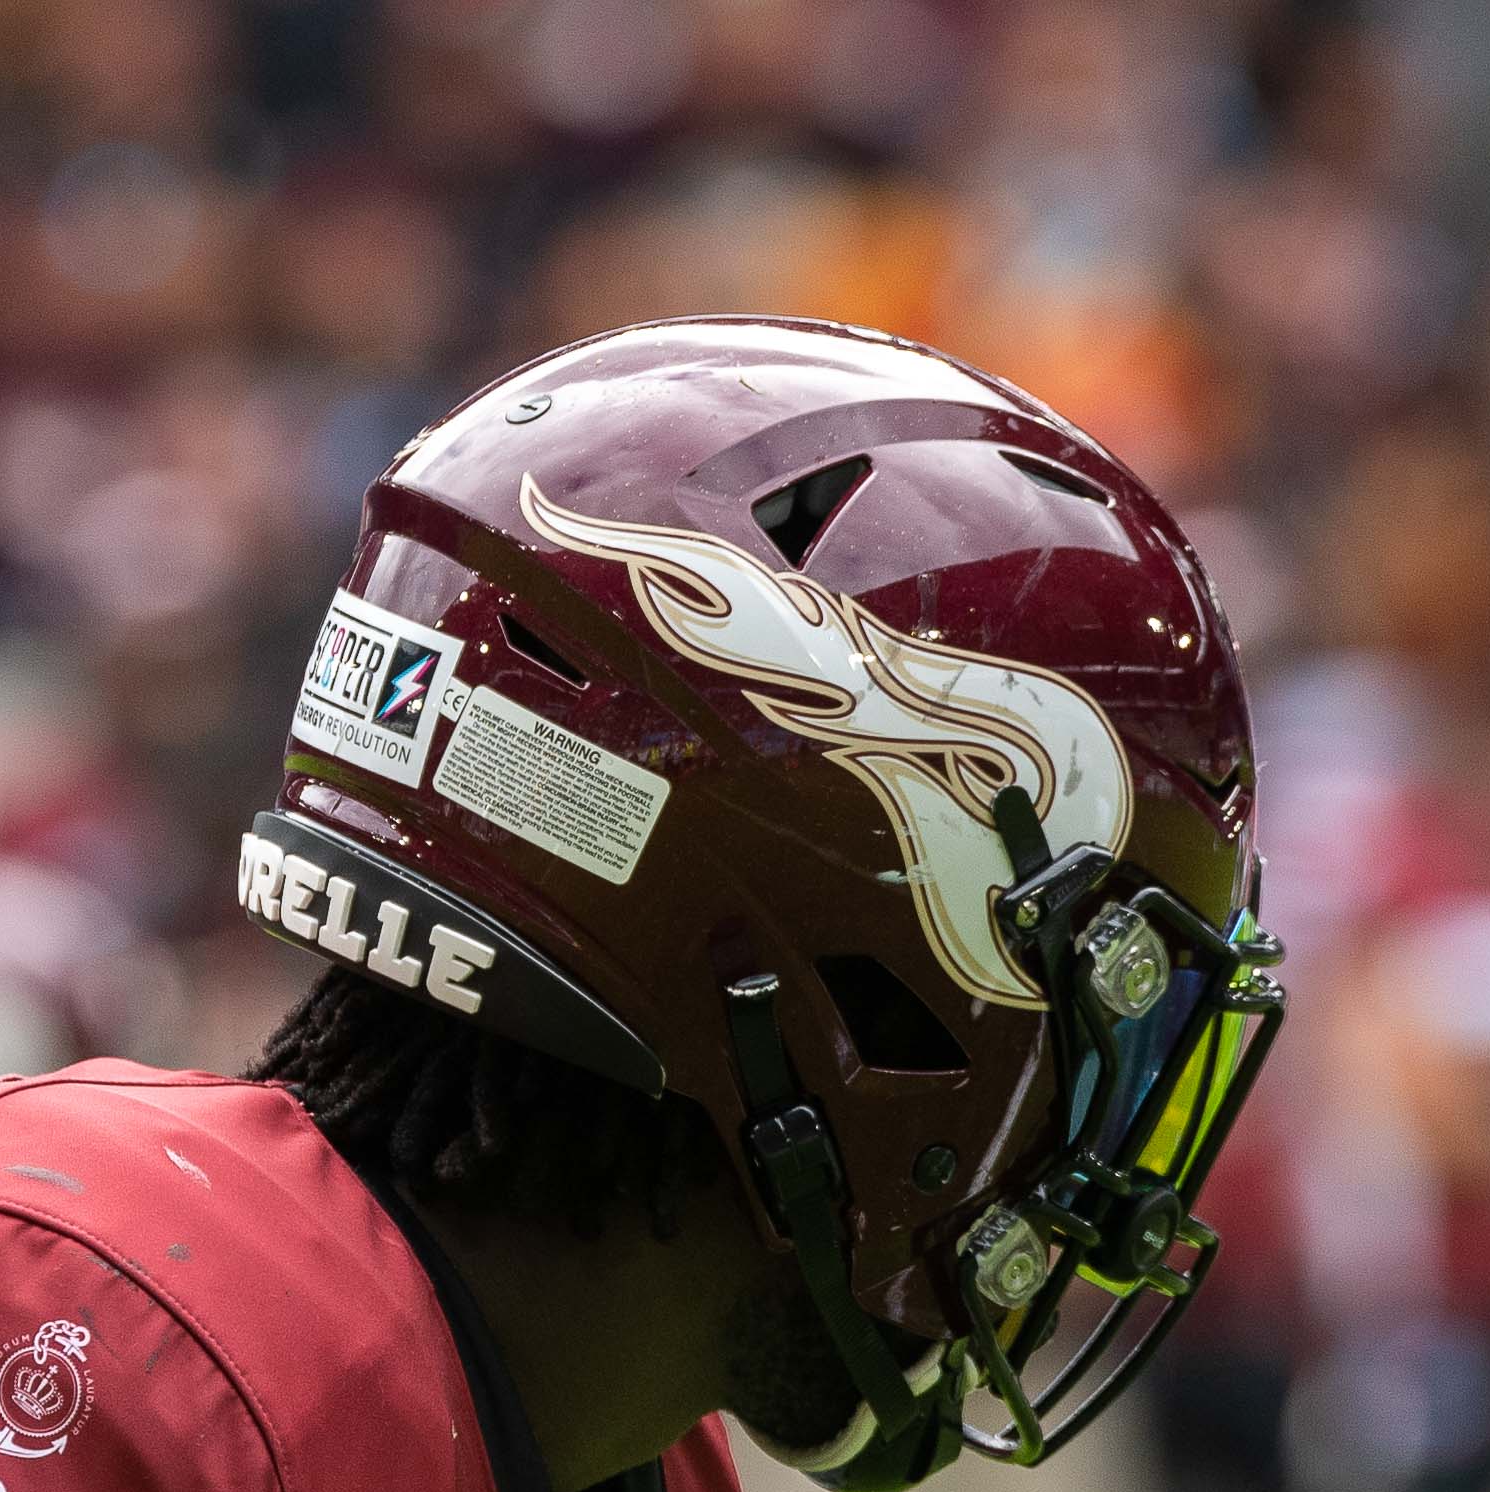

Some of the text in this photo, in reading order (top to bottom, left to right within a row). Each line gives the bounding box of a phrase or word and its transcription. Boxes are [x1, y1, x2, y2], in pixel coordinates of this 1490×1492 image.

[443, 688, 464, 712] CE
[297, 701, 324, 728] ENERGY
[326, 716, 411, 765] REVOLUTION
[472, 713, 497, 730] PLAYER
[495, 725, 516, 740] MIGHT
[514, 735, 543, 754] RECEIVE
[541, 748, 563, 764] WHILE
[562, 759, 610, 788] PARTICIPATING
[616, 787, 652, 811] FOOTBALL
[479, 708, 506, 726] HELMET
[503, 720, 520, 733] CAN
[517, 728, 548, 748] PREVENT
[546, 742, 576, 762] SERIOUS
[574, 757, 595, 772] HEAD
[603, 772, 624, 787] NECK
[533, 721, 601, 766] WARNING
[71, 1369, 95, 1436] LAUDATUR
